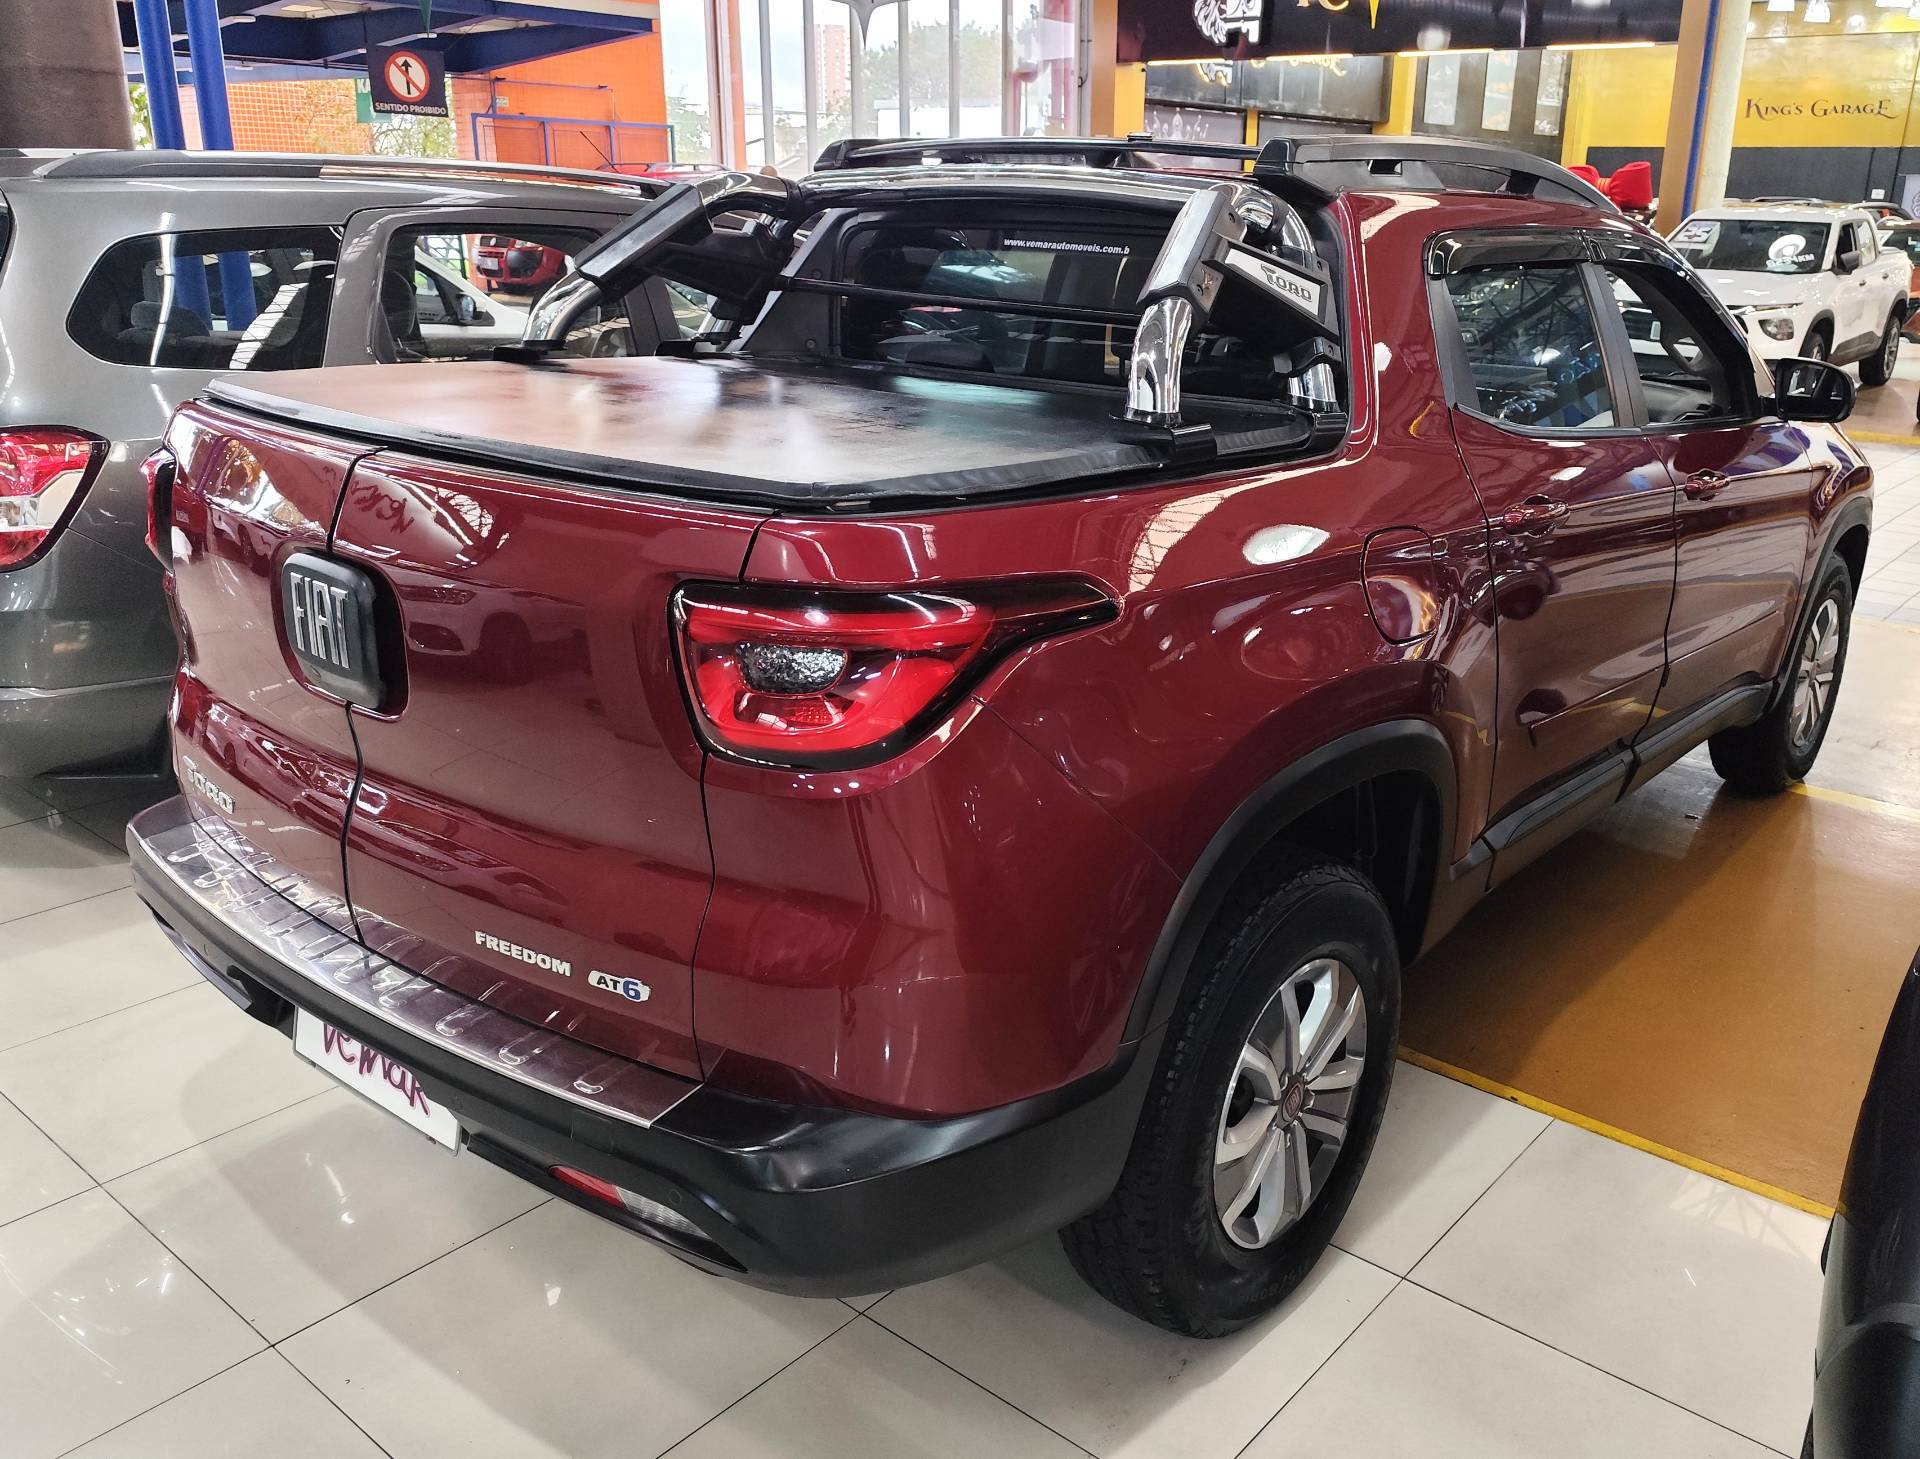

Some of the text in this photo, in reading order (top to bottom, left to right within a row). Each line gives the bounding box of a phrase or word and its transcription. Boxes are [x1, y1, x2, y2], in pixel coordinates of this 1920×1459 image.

[375, 102, 447, 115] SENTIDO PROIBIDO
[1810, 99, 1898, 119] GARAGE
[1260, 264, 1313, 303] TORO
[290, 572, 350, 669] FIAT
[474, 930, 572, 977] FREEDOM
[595, 974, 643, 1001] AT6
